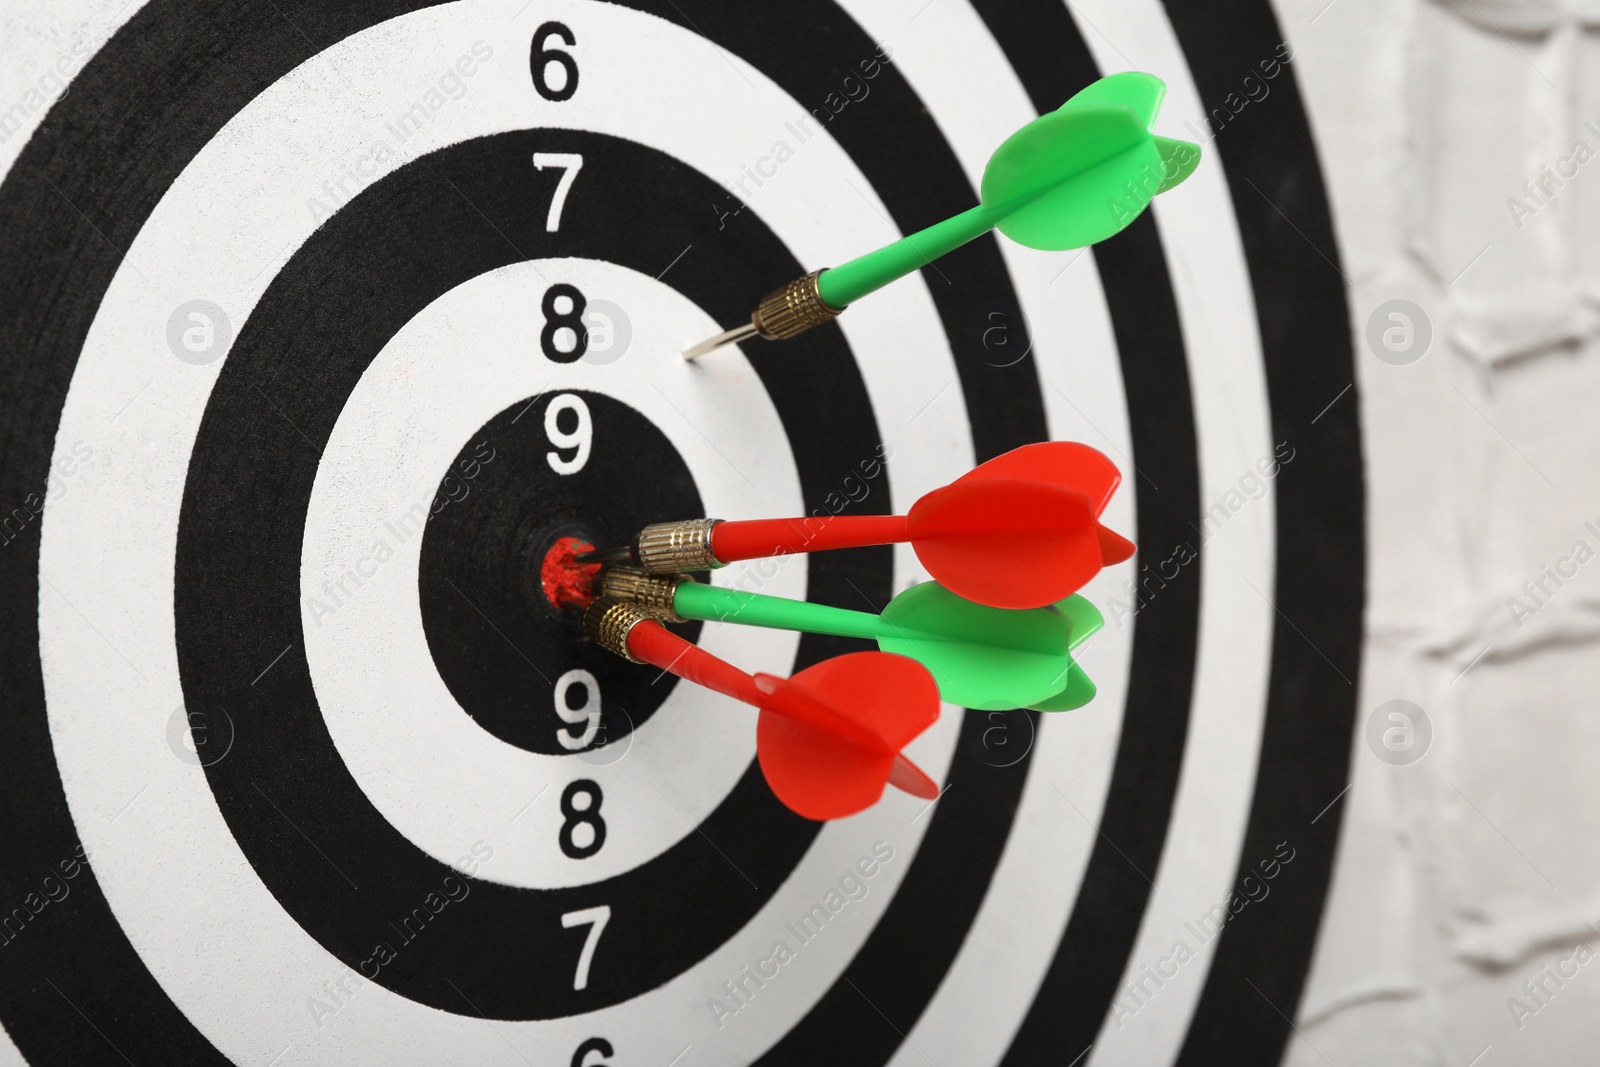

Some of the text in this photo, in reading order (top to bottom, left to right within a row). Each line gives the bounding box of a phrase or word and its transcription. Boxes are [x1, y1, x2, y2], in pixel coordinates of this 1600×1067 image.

[529, 21, 579, 102] 6
[532, 152, 584, 233] 7
[540, 283, 589, 364] 8
[543, 393, 593, 476] 9
[554, 669, 602, 750] 9
[558, 779, 607, 859] 8
[561, 906, 611, 990] 7
